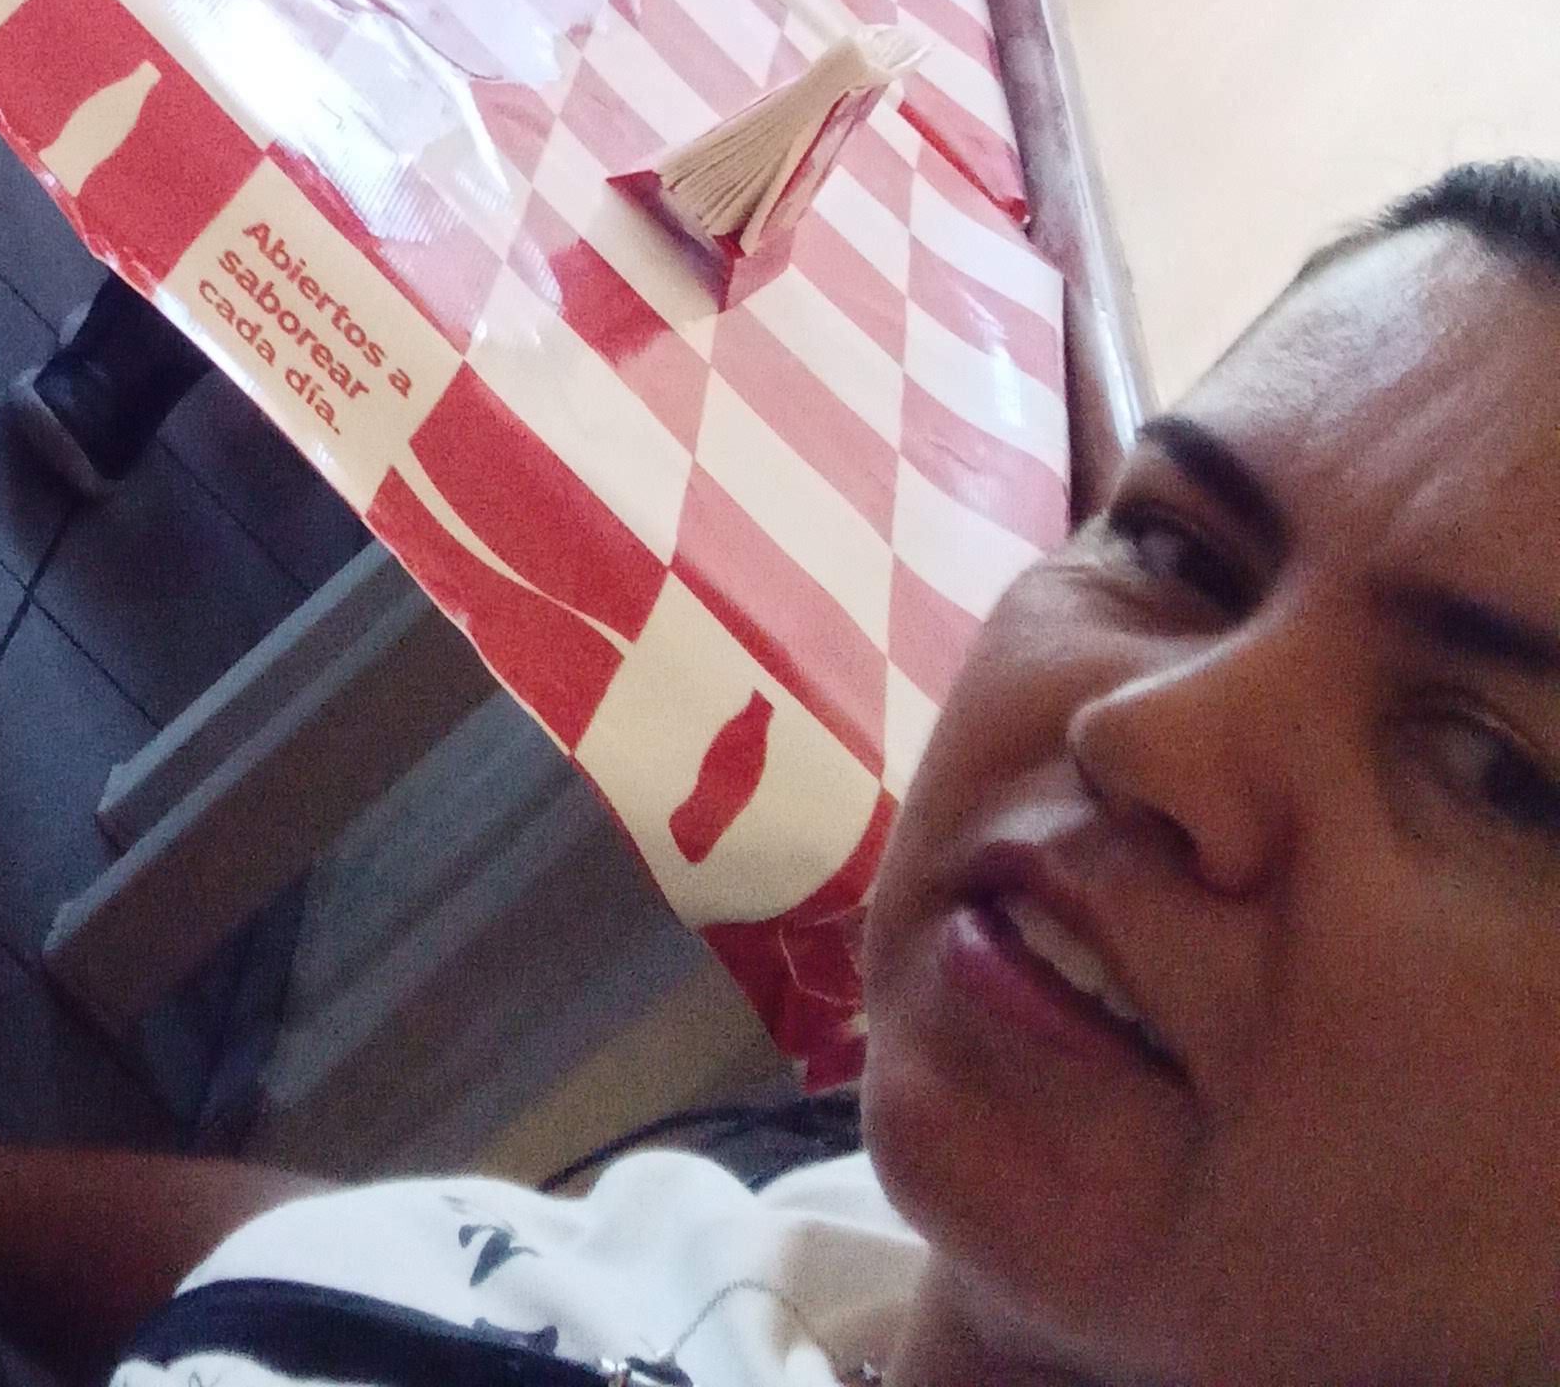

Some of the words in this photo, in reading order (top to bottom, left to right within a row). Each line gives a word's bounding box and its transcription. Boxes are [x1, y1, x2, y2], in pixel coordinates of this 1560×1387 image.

[198, 278, 277, 368] cada
[284, 367, 342, 436] día.
[217, 249, 371, 400] saborear
[242, 221, 389, 369] Abiertos
[388, 367, 414, 400] a
